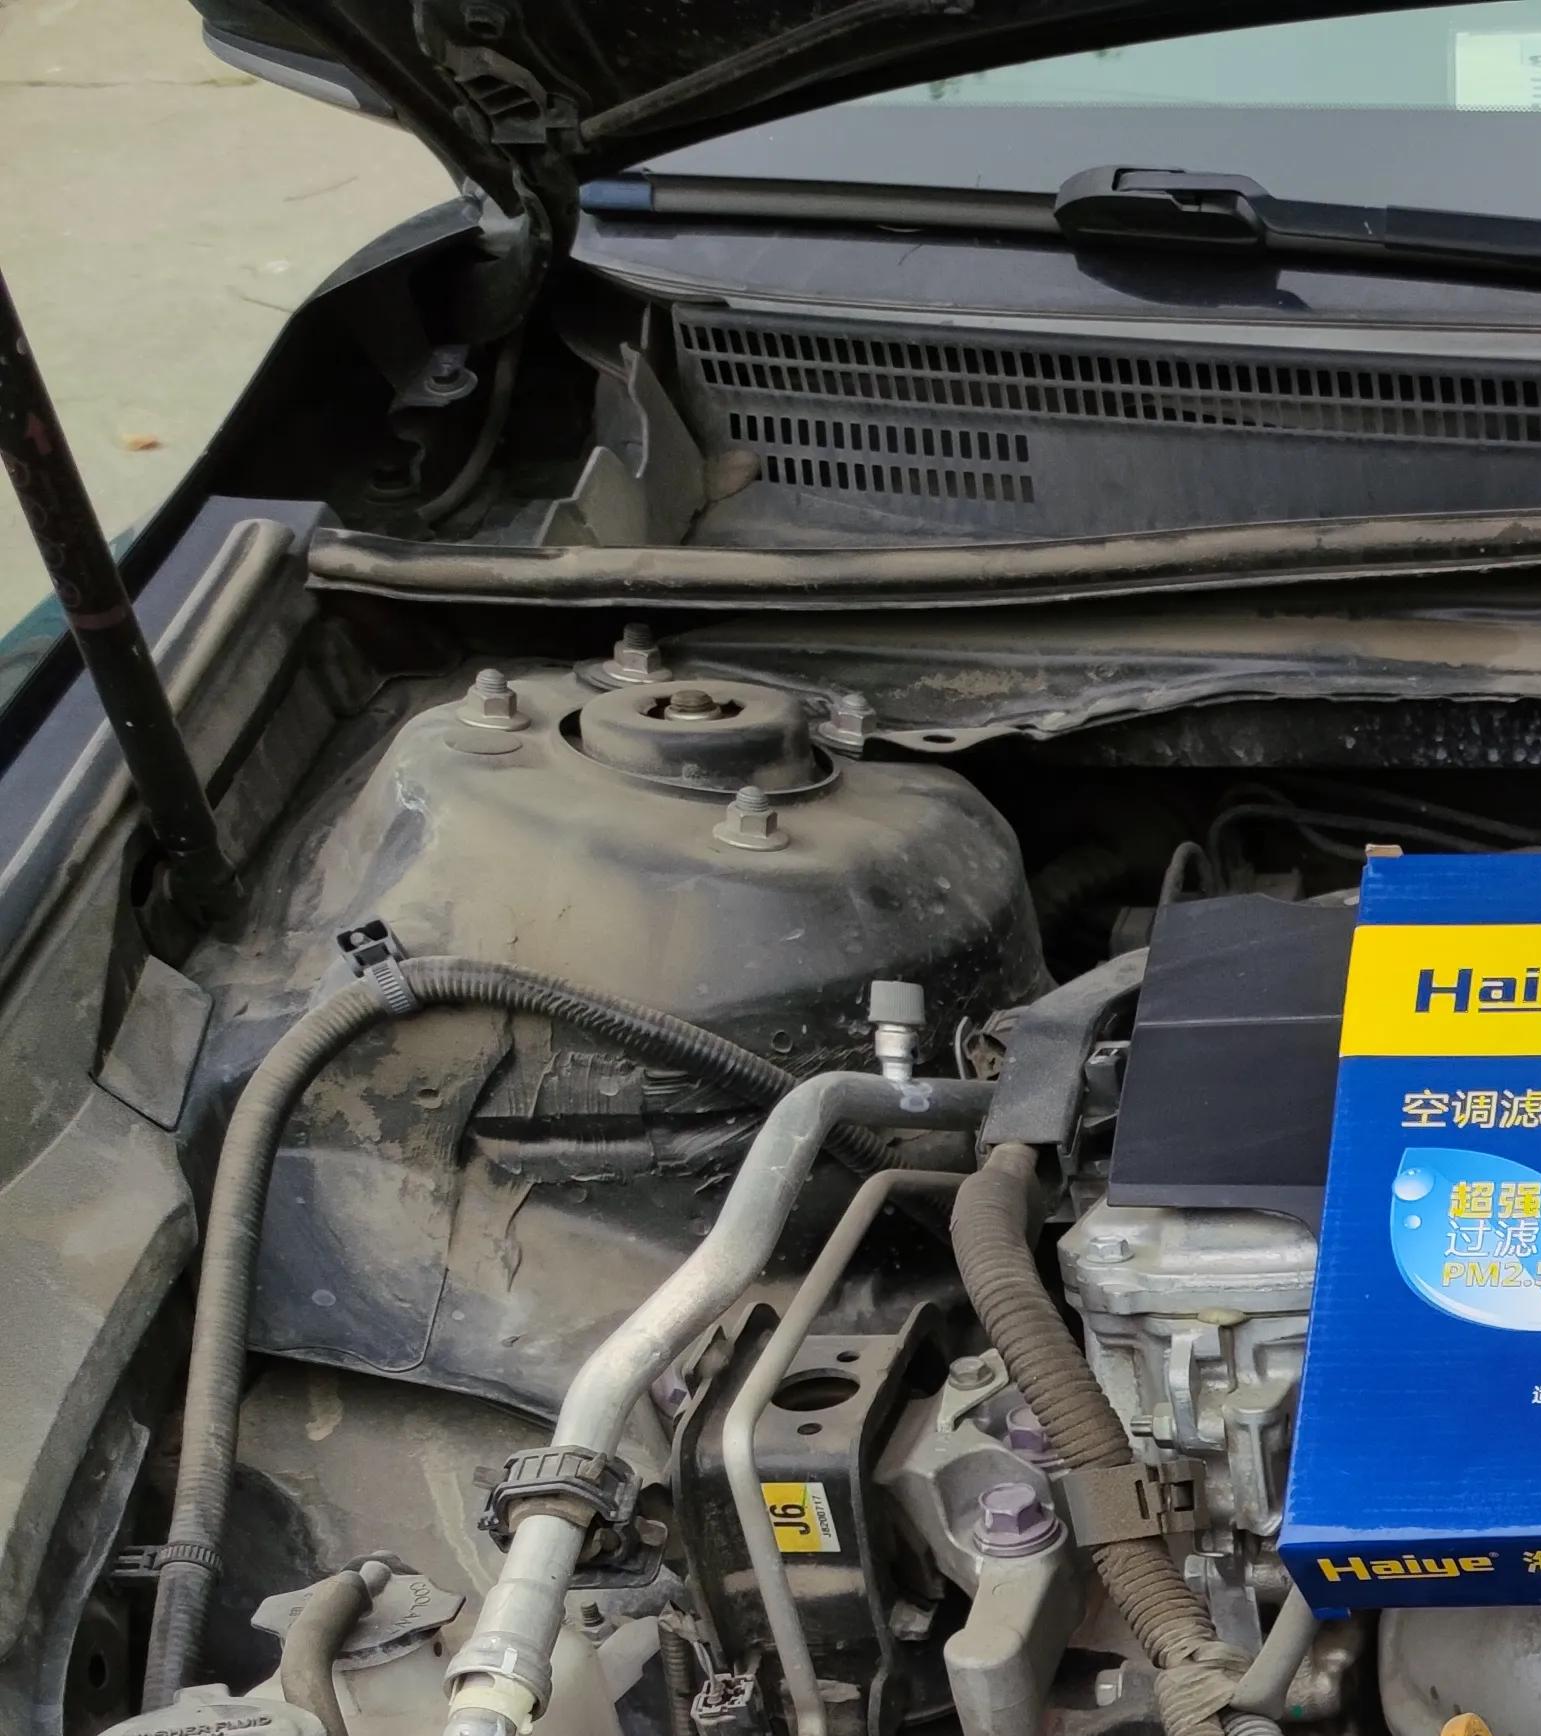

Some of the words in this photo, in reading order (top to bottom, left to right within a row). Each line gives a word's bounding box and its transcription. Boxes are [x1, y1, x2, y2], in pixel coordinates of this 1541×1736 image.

[1449, 1180, 1541, 1219] 超强
[1444, 1219, 1540, 1258] 过滤
[769, 1503, 811, 1535] J6
[1317, 1554, 1495, 1582] Haiye
[216, 1715, 273, 1734] FLUID
